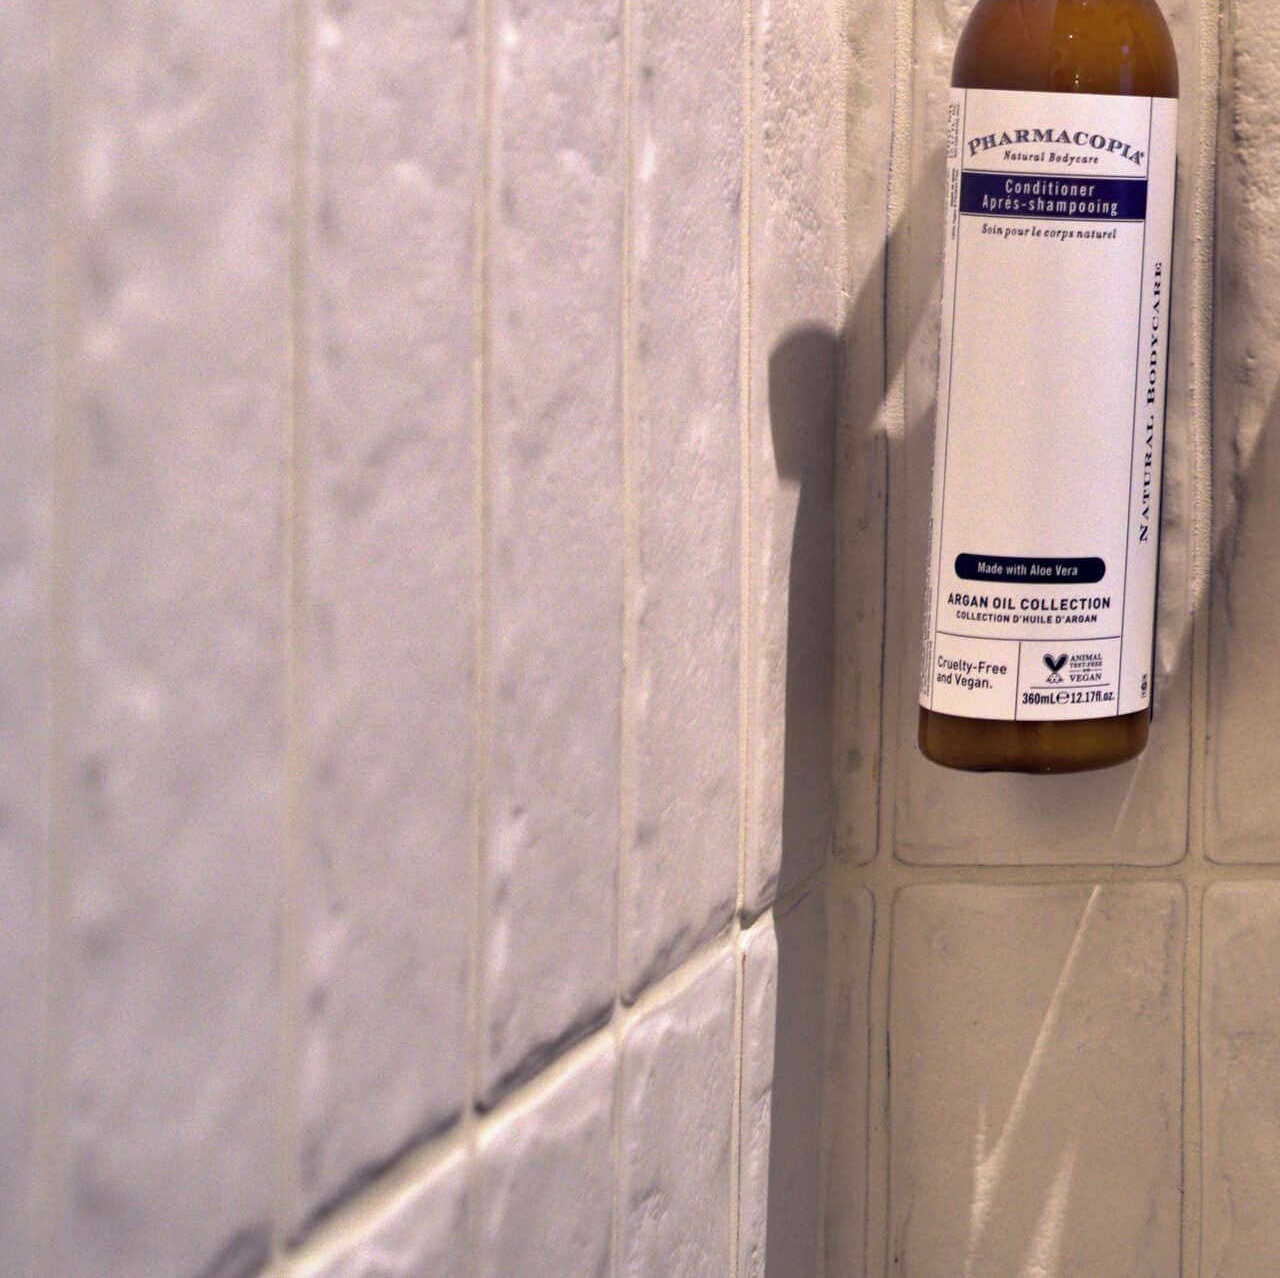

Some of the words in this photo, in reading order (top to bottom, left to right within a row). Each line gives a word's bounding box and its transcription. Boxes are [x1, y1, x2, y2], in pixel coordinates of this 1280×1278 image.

[967, 129, 1142, 165] PHARMACOPIA
[1004, 151, 1044, 162] Natural
[1050, 152, 1099, 165] Bodycare
[1005, 179, 1095, 196] Conditioner
[981, 224, 1003, 235] Soin
[1005, 227, 1030, 238] pour
[1032, 226, 1042, 237] le
[1043, 229, 1073, 241] corps
[1076, 229, 1116, 239] naturel
[978, 562, 1003, 574] Made
[1006, 564, 1027, 575] with
[1030, 564, 1052, 576] Aloe
[1056, 565, 1078, 576] Vera
[948, 593, 988, 608] ARGAN
[993, 597, 1015, 610] OIL
[1020, 597, 1110, 610] COLLECTION
[956, 611, 1009, 622] COLLECTION
[1013, 615, 1052, 623] D'HUILE
[1056, 615, 1097, 623] D'ARGAN
[937, 656, 1007, 674] Cruelty-Free
[937, 673, 951, 685] and
[954, 676, 992, 690] Vegan.
[1069, 673, 1102, 682] VEGAN
